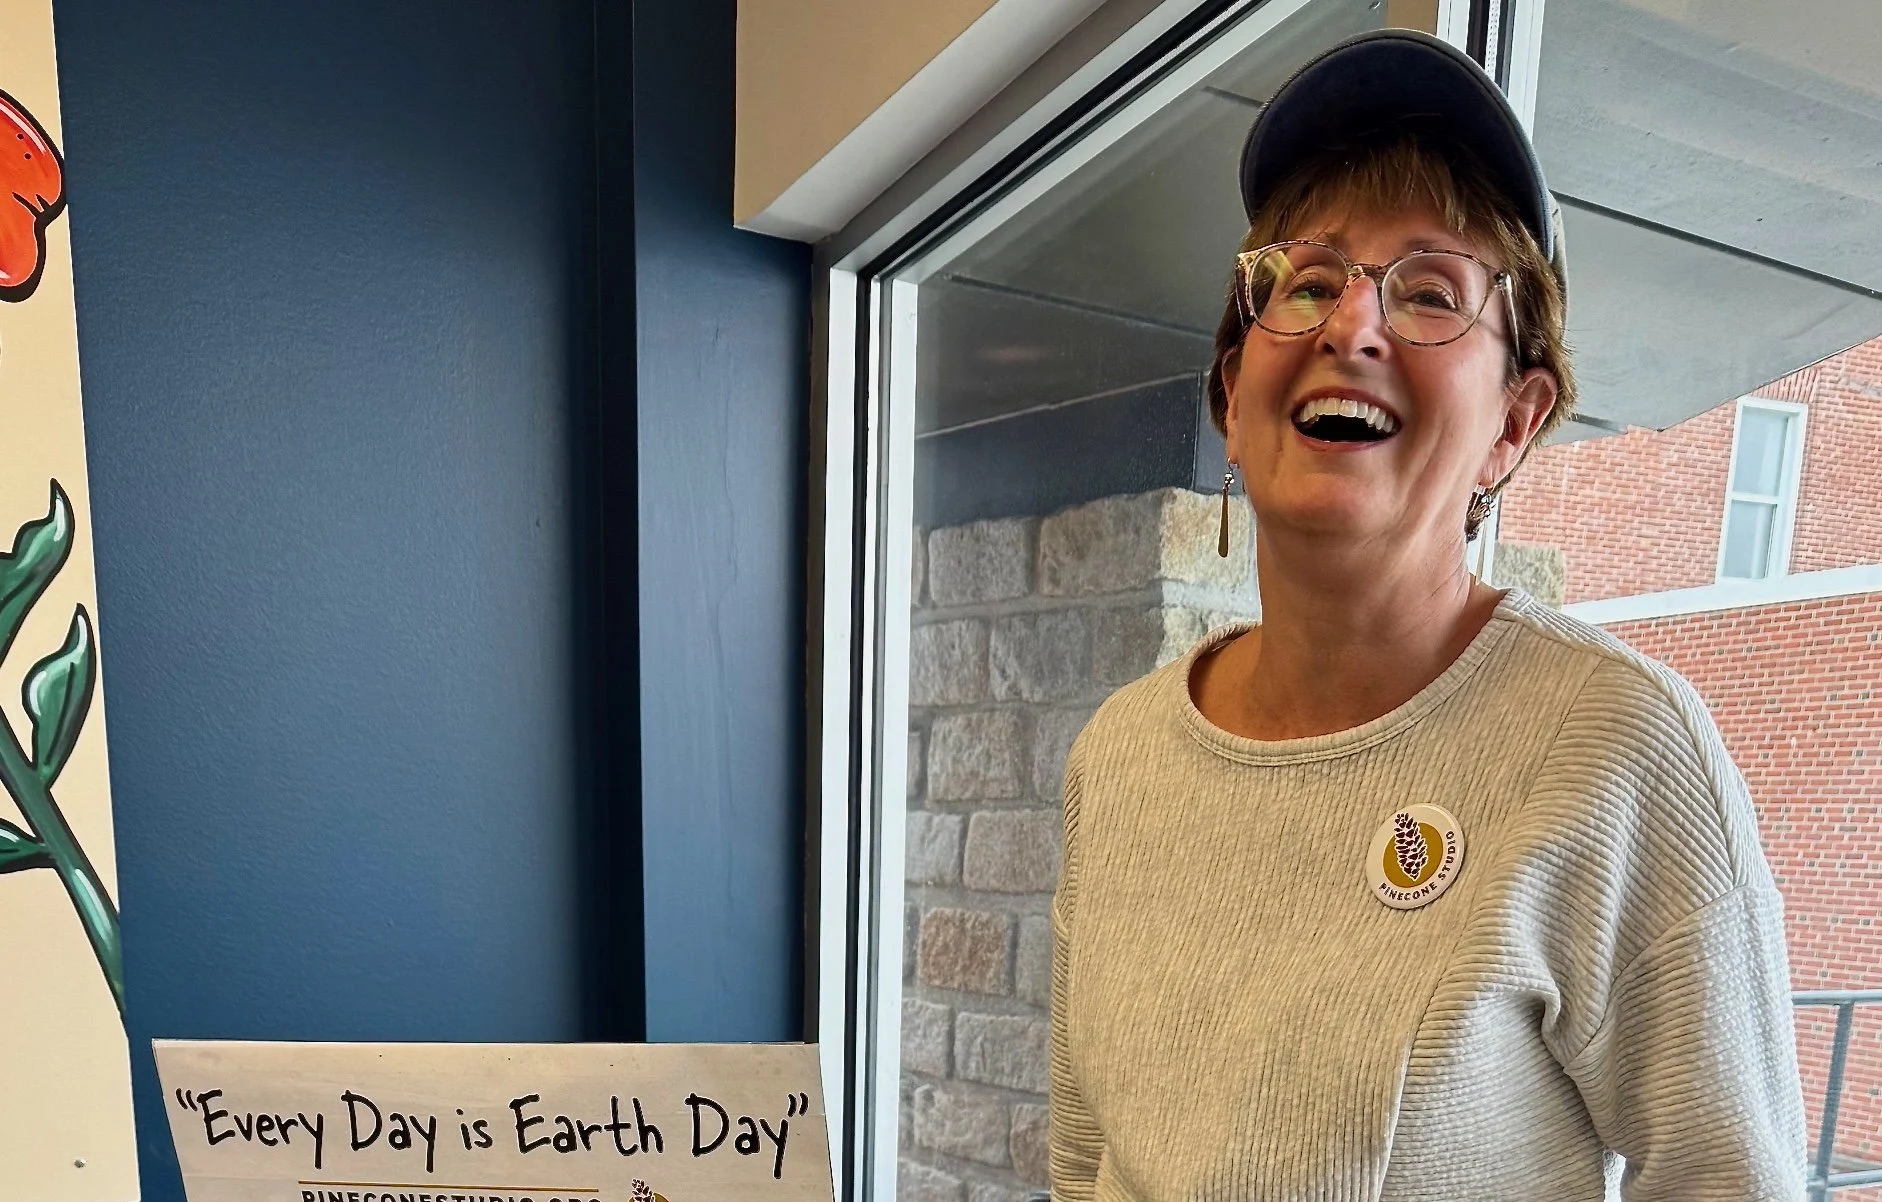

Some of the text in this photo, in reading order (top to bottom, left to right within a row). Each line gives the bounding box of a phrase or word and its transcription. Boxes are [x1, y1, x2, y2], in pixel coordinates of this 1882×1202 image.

[1378, 830, 1456, 901] PINECONE STUDIO
[341, 1089, 437, 1173] Day
[456, 1107, 494, 1150] is
[508, 1093, 664, 1157] Earth
